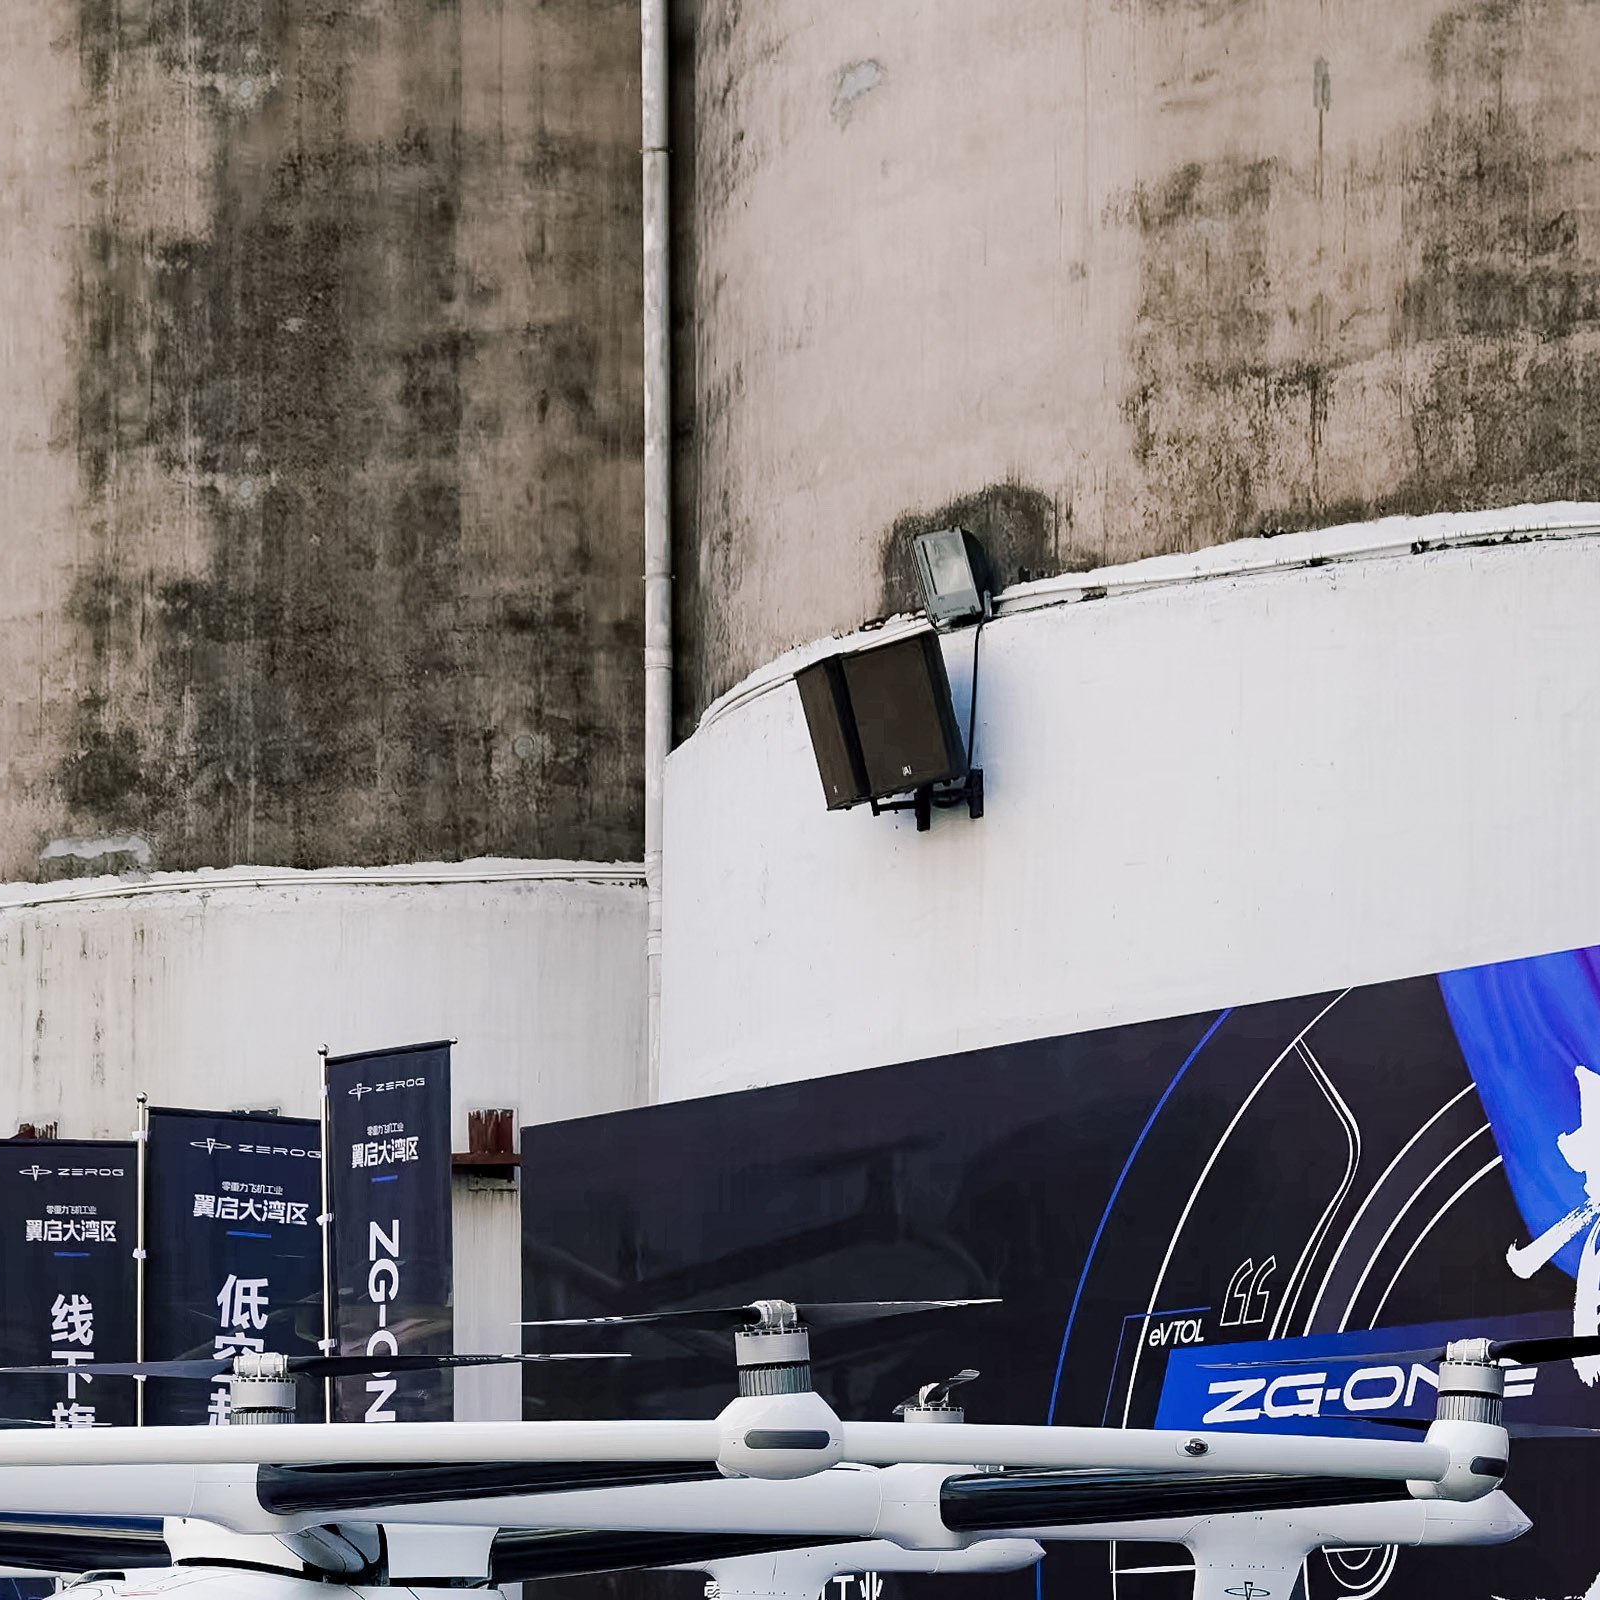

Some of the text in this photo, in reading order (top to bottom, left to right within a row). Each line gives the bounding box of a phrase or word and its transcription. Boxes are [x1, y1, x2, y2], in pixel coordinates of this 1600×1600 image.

[376, 1077, 425, 1091] ZEROG
[238, 1144, 321, 1159] ZEROG
[351, 1136, 419, 1169] 翼启大湾区
[57, 1168, 124, 1177] ZEROG
[193, 1193, 309, 1226] 翼启大湾区
[25, 1219, 117, 1242] 翼启大湾区
[1149, 1318, 1204, 1347] eVTOL
